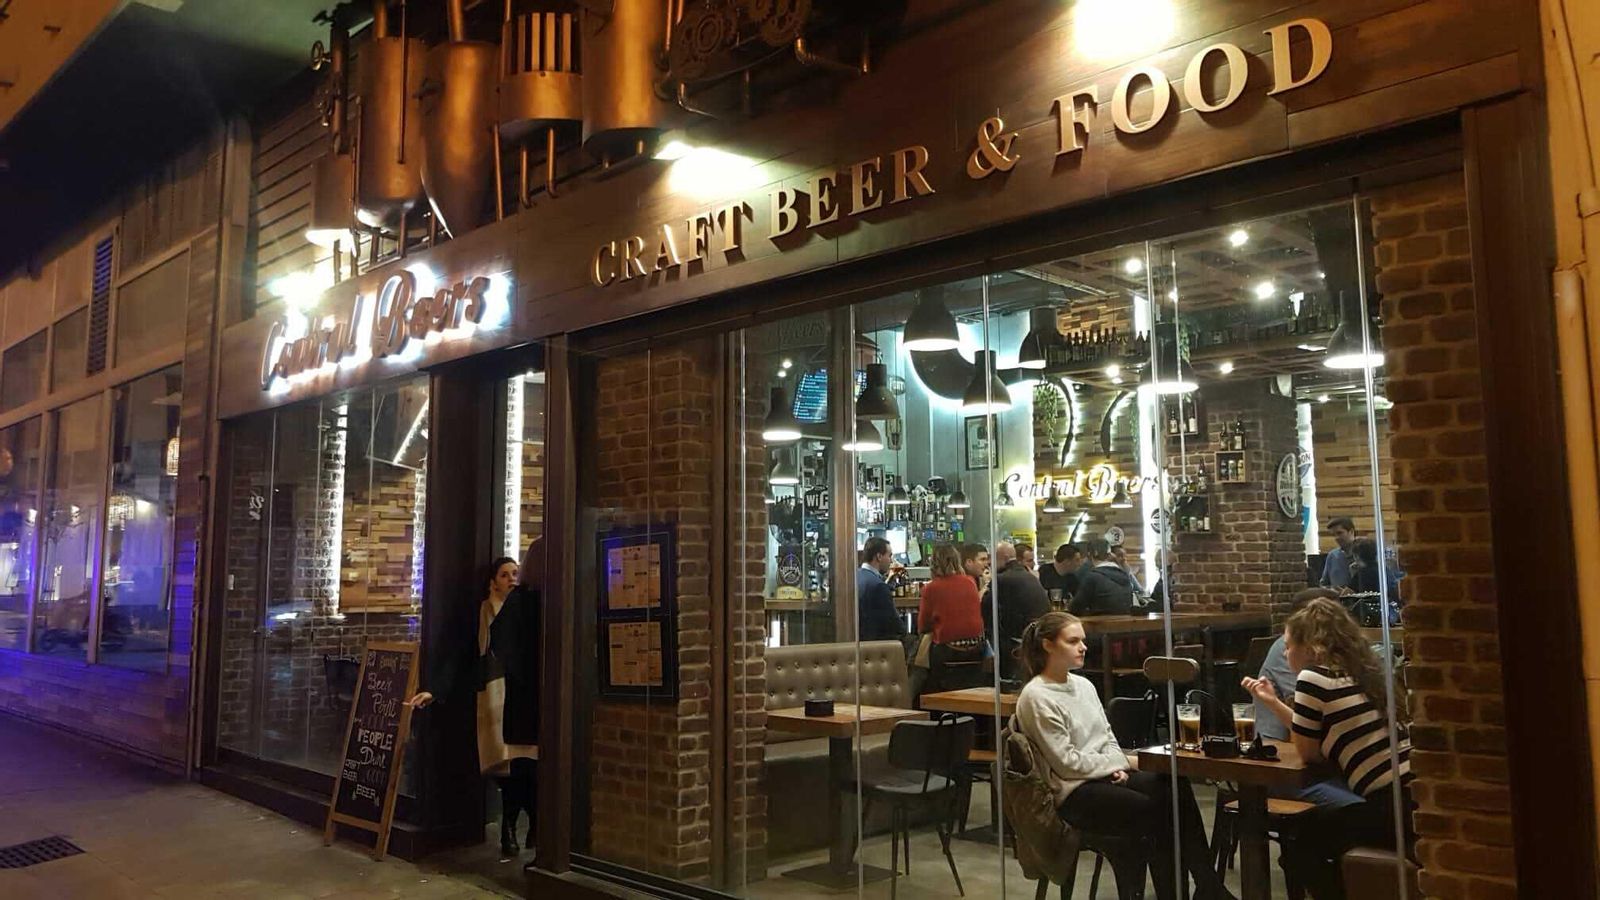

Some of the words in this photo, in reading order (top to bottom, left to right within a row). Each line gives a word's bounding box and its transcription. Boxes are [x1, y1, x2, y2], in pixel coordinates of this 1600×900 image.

[591, 199, 745, 287] CRAFT
[768, 145, 936, 240] BEER
[967, 116, 1021, 180] &
[1053, 17, 1334, 156] FOOD
[261, 293, 364, 392] Central
[371, 269, 491, 358] Beers
[1085, 465, 1160, 498] Bers
[357, 728, 394, 752] PEOPLE
[356, 783, 376, 799] BEER
